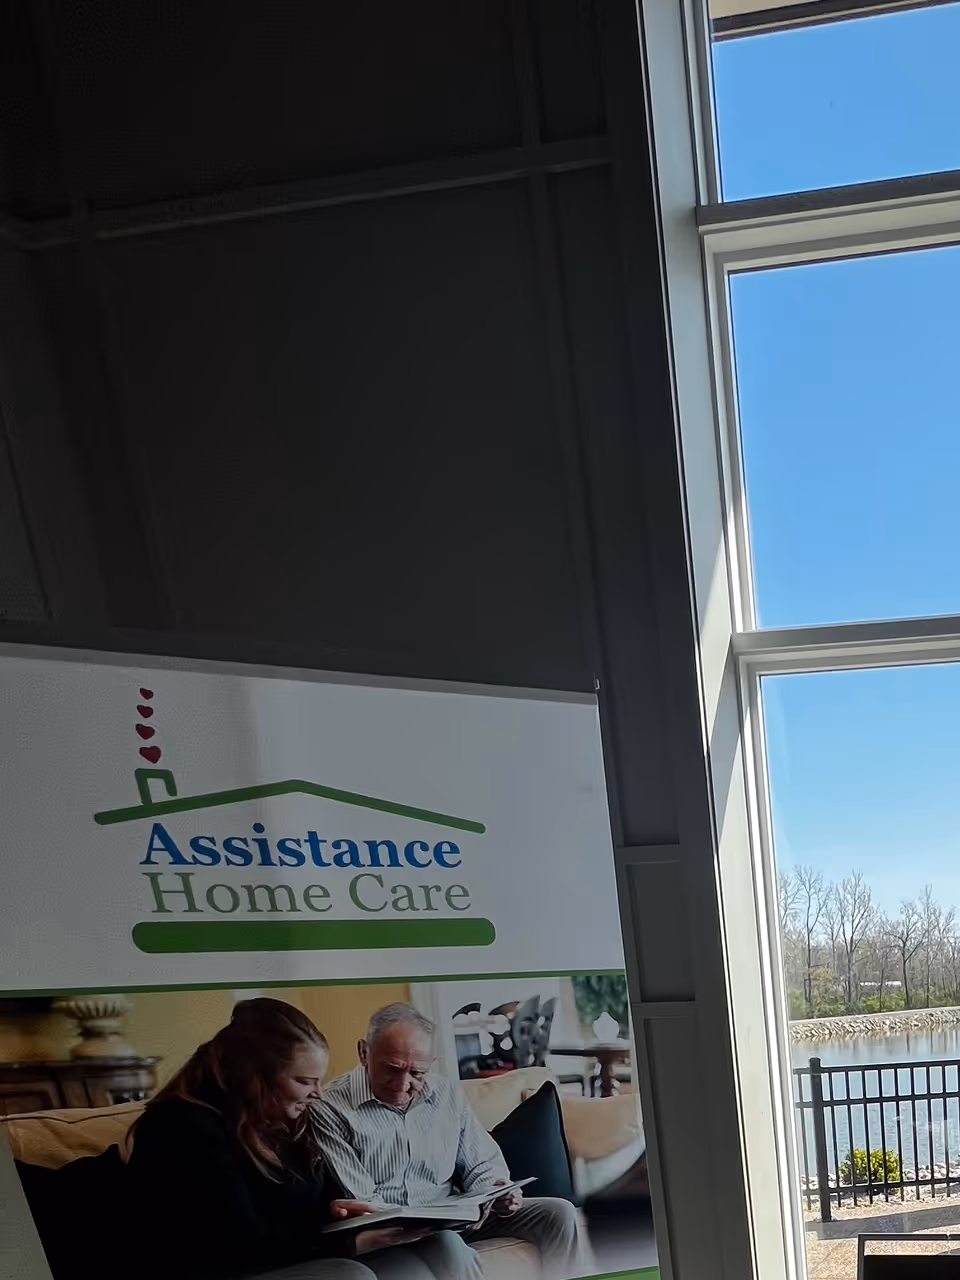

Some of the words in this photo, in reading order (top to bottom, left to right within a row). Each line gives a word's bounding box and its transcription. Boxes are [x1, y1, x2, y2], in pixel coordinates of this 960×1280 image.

[139, 823, 462, 868] Assistance
[142, 872, 333, 913] Home
[348, 873, 472, 912] Care
